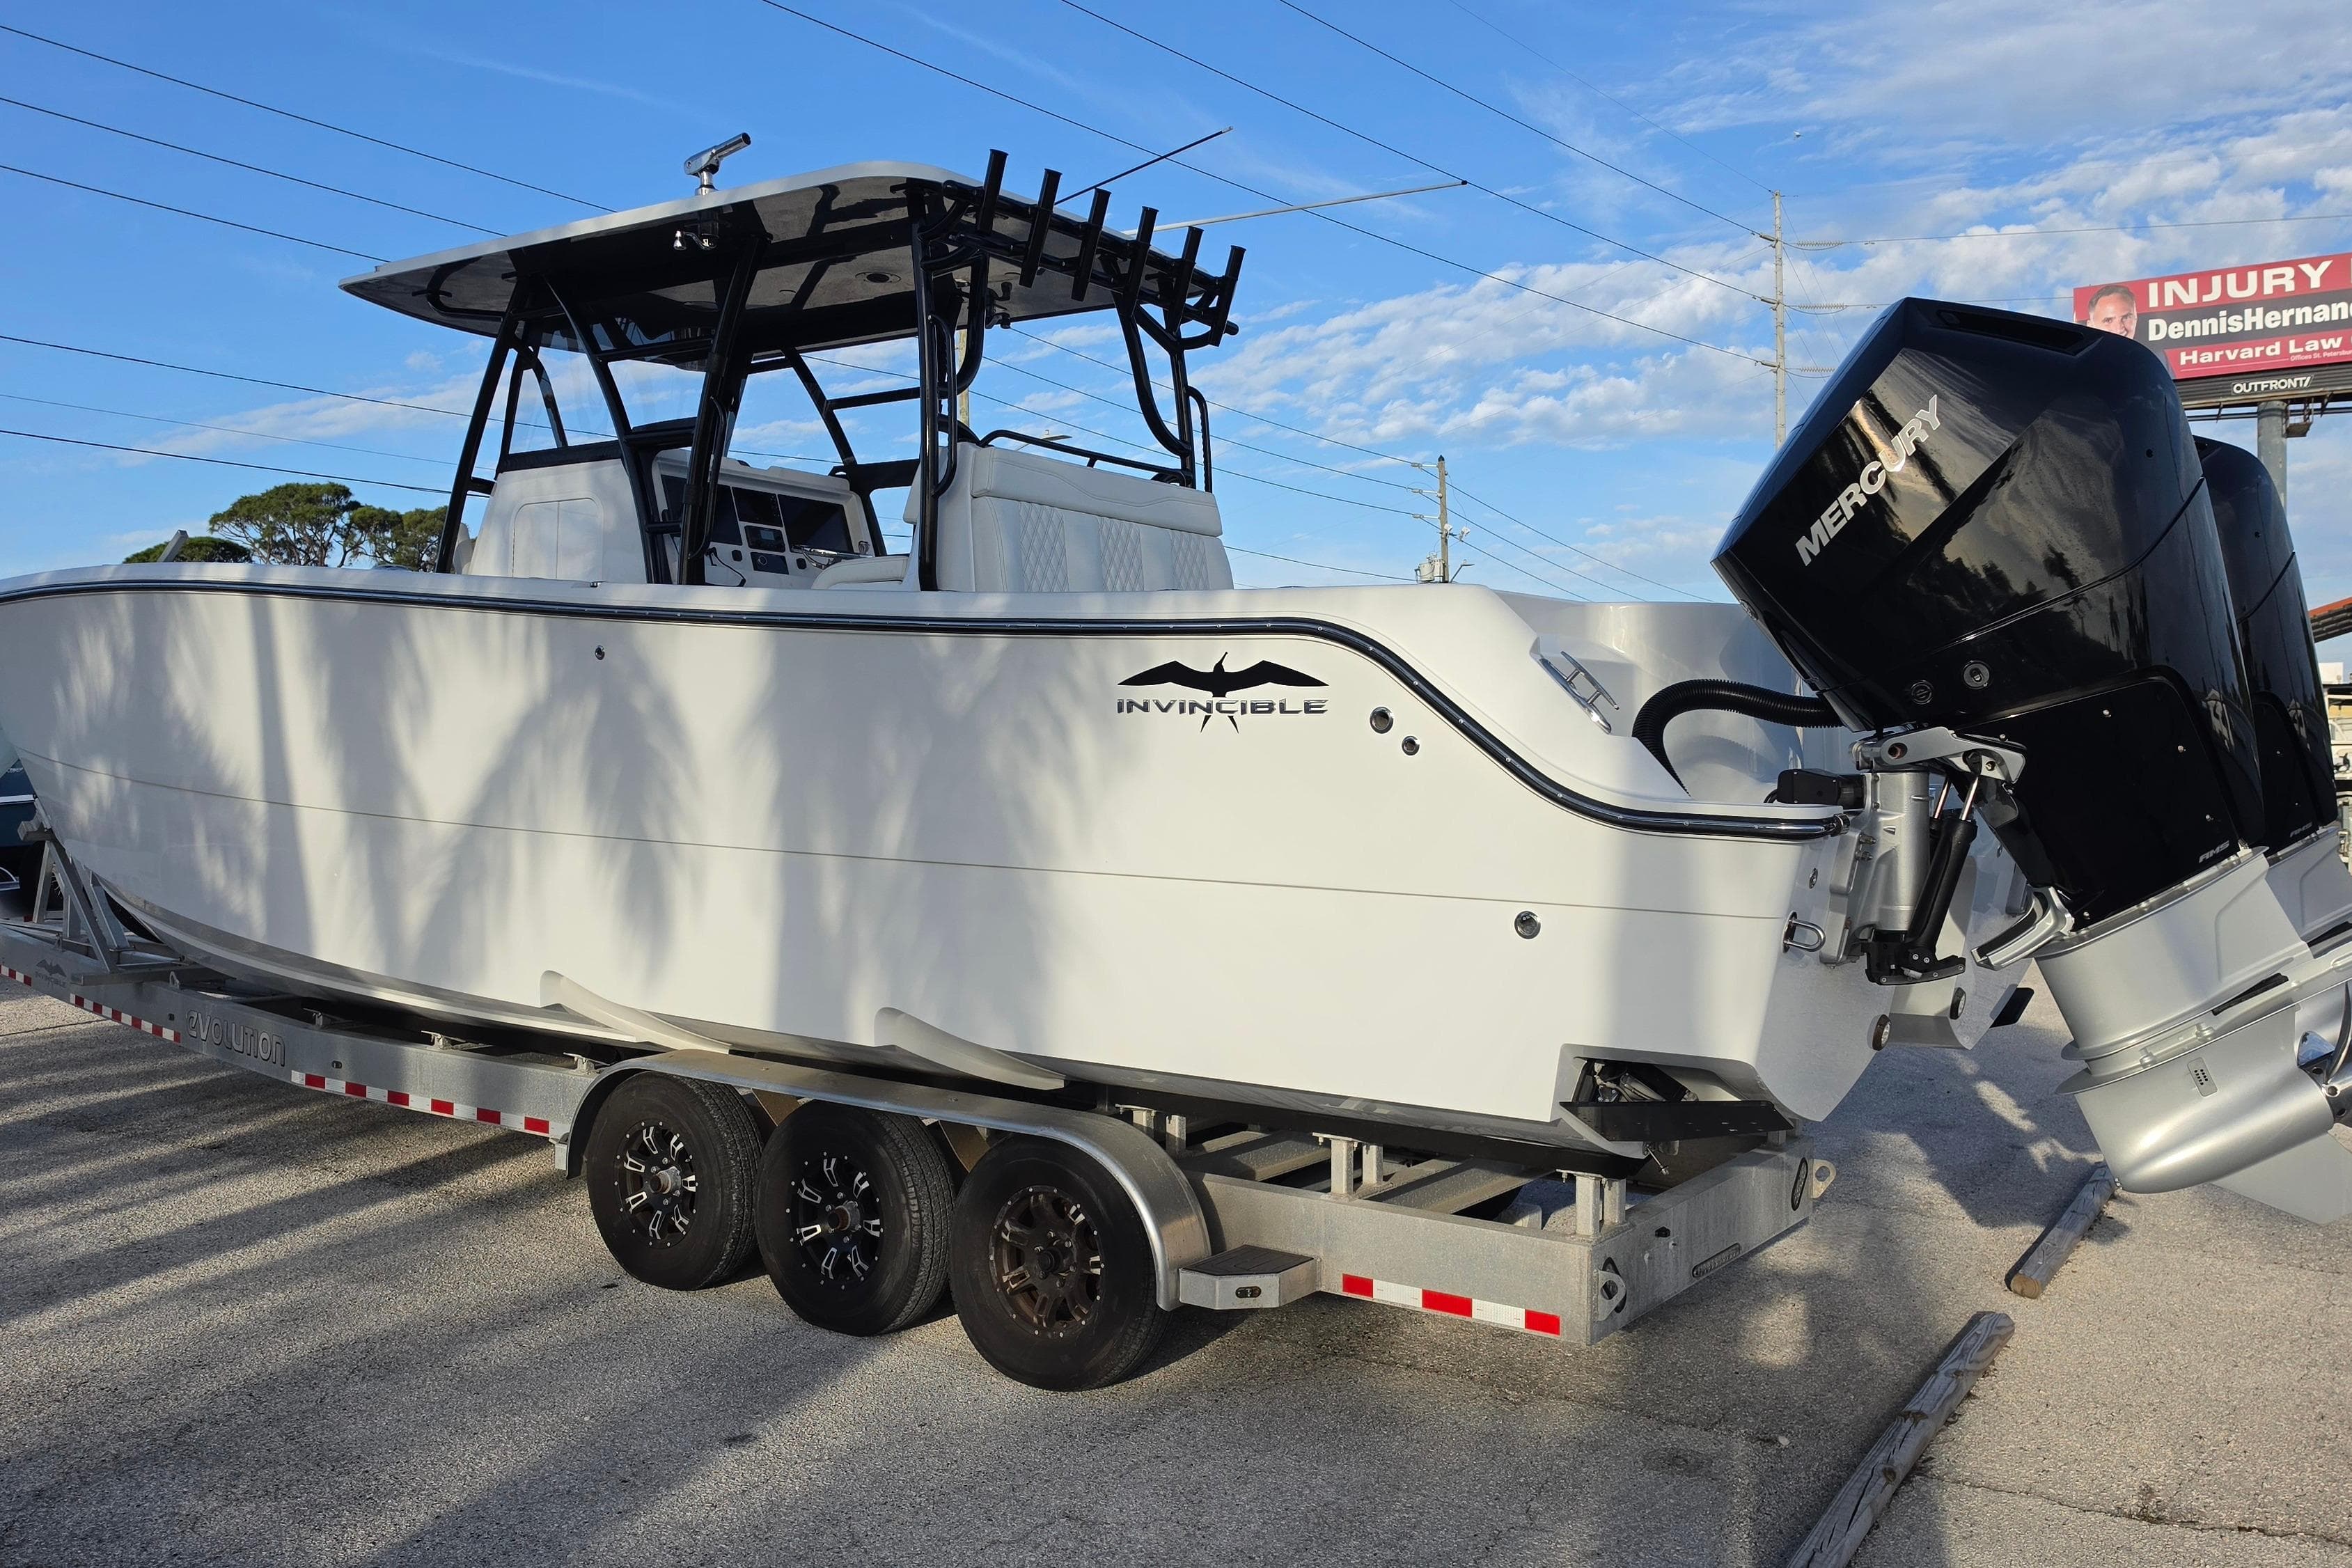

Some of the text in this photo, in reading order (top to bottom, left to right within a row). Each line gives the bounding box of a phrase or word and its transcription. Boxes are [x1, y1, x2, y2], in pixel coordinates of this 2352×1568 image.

[2149, 260, 2333, 308] INJURY
[2180, 336, 2343, 366] Harvard Law
[1795, 394, 1941, 566] MERCURY
[1117, 698, 1329, 714] INVINCIBLE
[2199, 840, 2229, 863] AMS
